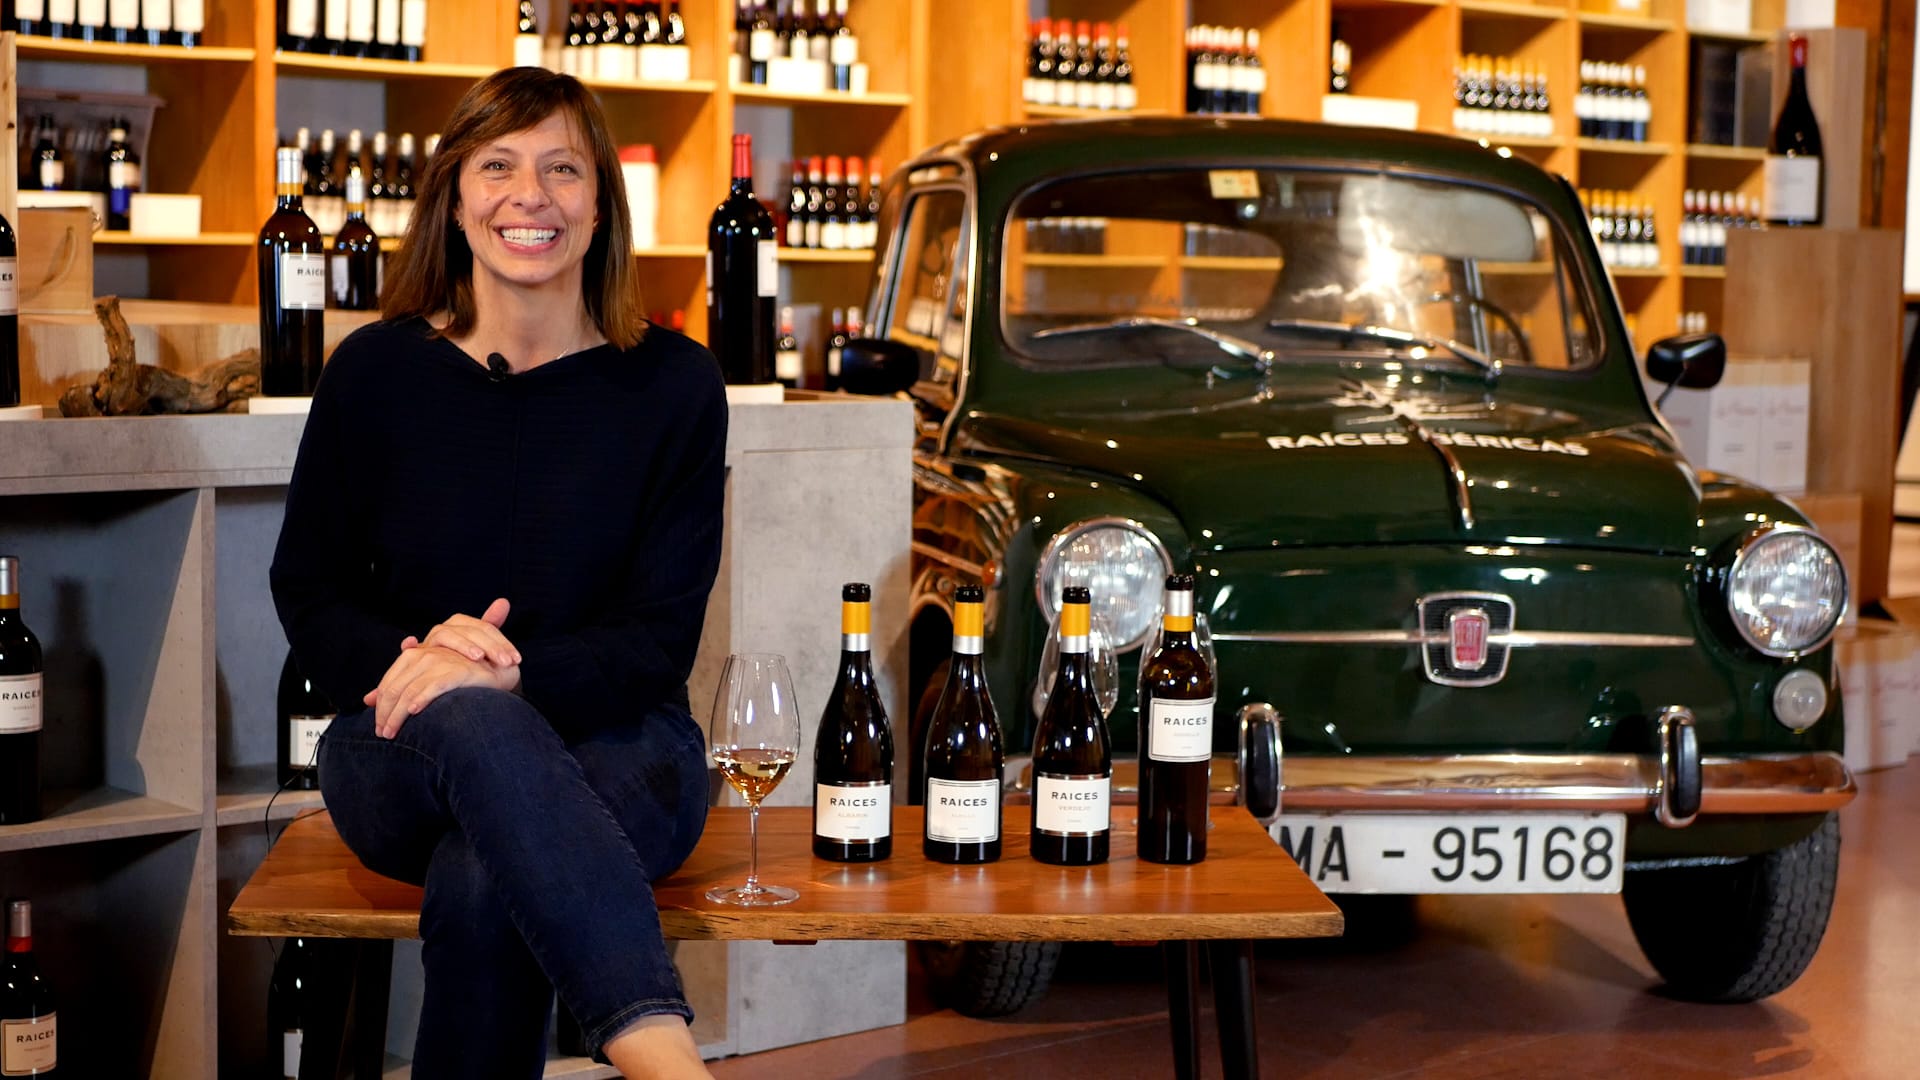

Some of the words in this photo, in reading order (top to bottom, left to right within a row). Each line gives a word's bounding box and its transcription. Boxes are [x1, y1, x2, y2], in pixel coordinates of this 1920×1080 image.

[1266, 431, 1410, 449] RAÍCES
[1163, 717, 1208, 726] RAICES
[1051, 791, 1098, 801] RAICES
[830, 797, 877, 807] RAICES
[940, 797, 988, 807] RAICES
[1279, 826, 1350, 882] MA
[1431, 826, 1614, 882] 95168
